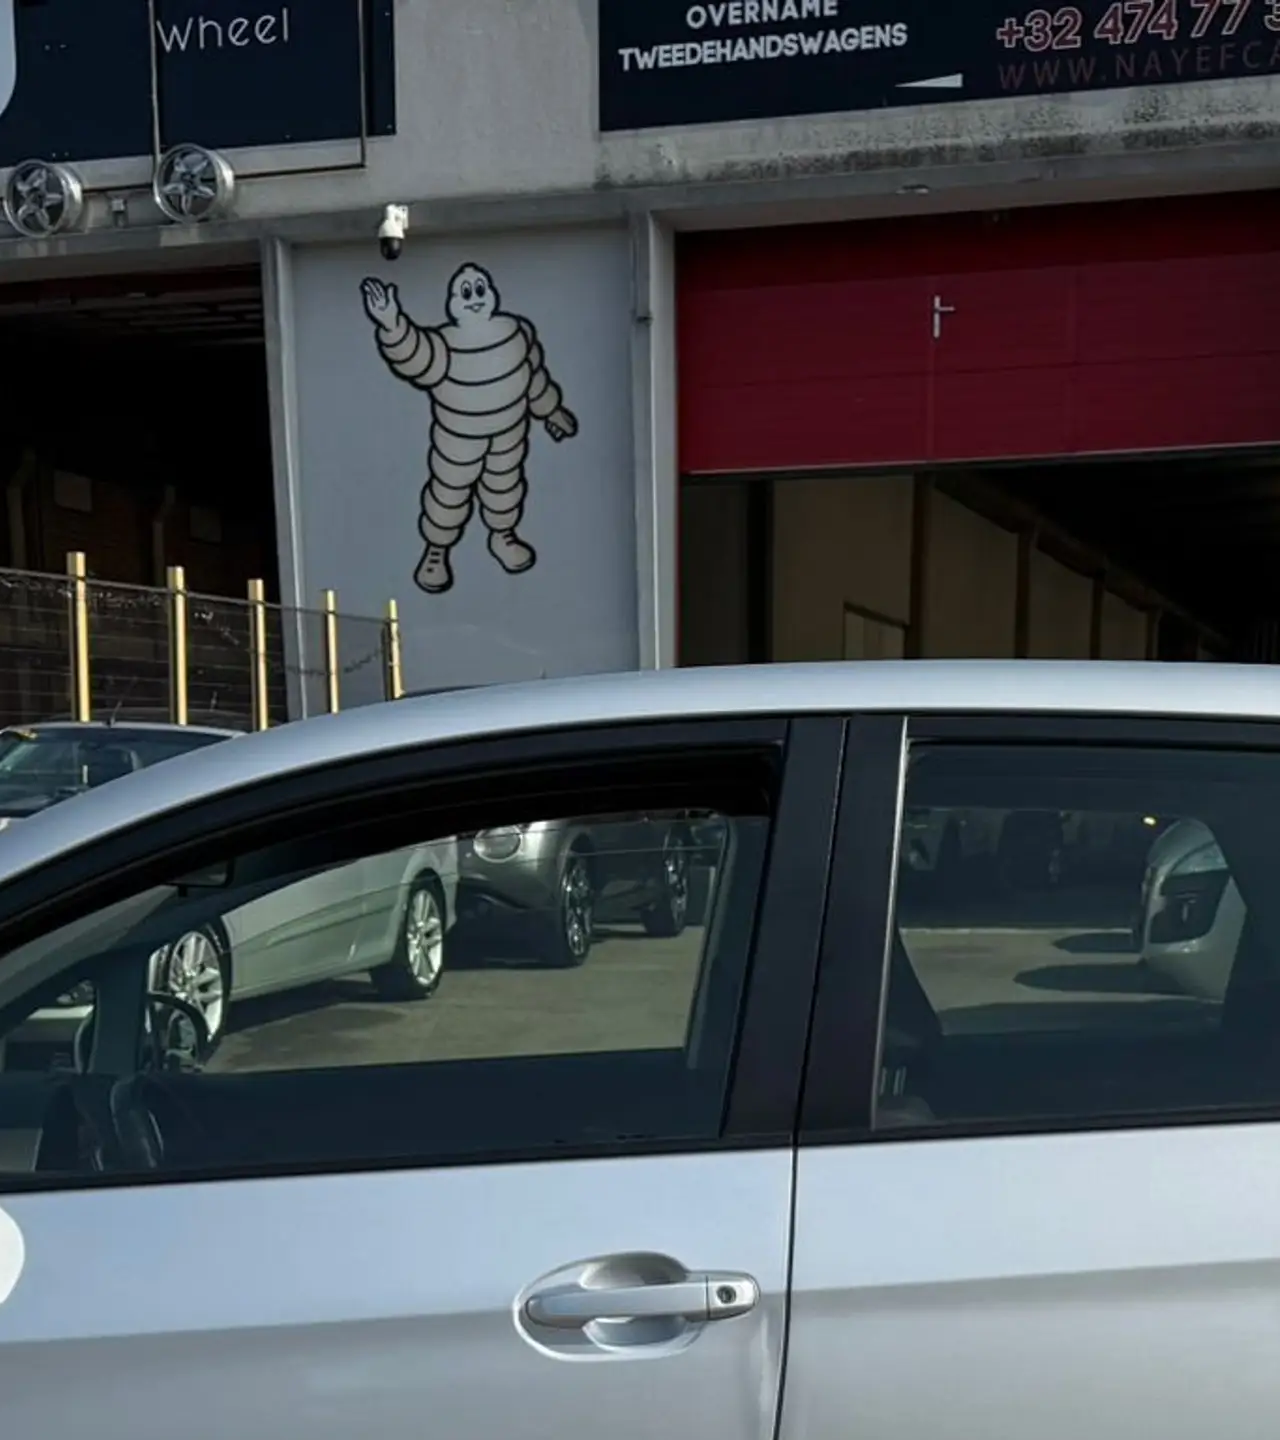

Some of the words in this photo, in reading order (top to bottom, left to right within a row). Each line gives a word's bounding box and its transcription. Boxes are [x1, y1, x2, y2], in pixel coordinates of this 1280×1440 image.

[686, 0, 838, 29] OVERNAME
[995, 7, 1083, 52] +32
[1094, 0, 1178, 45] 474
[1190, 0, 1253, 38] 77
[619, 23, 908, 71] TWEEDEHANDSWAGENS
